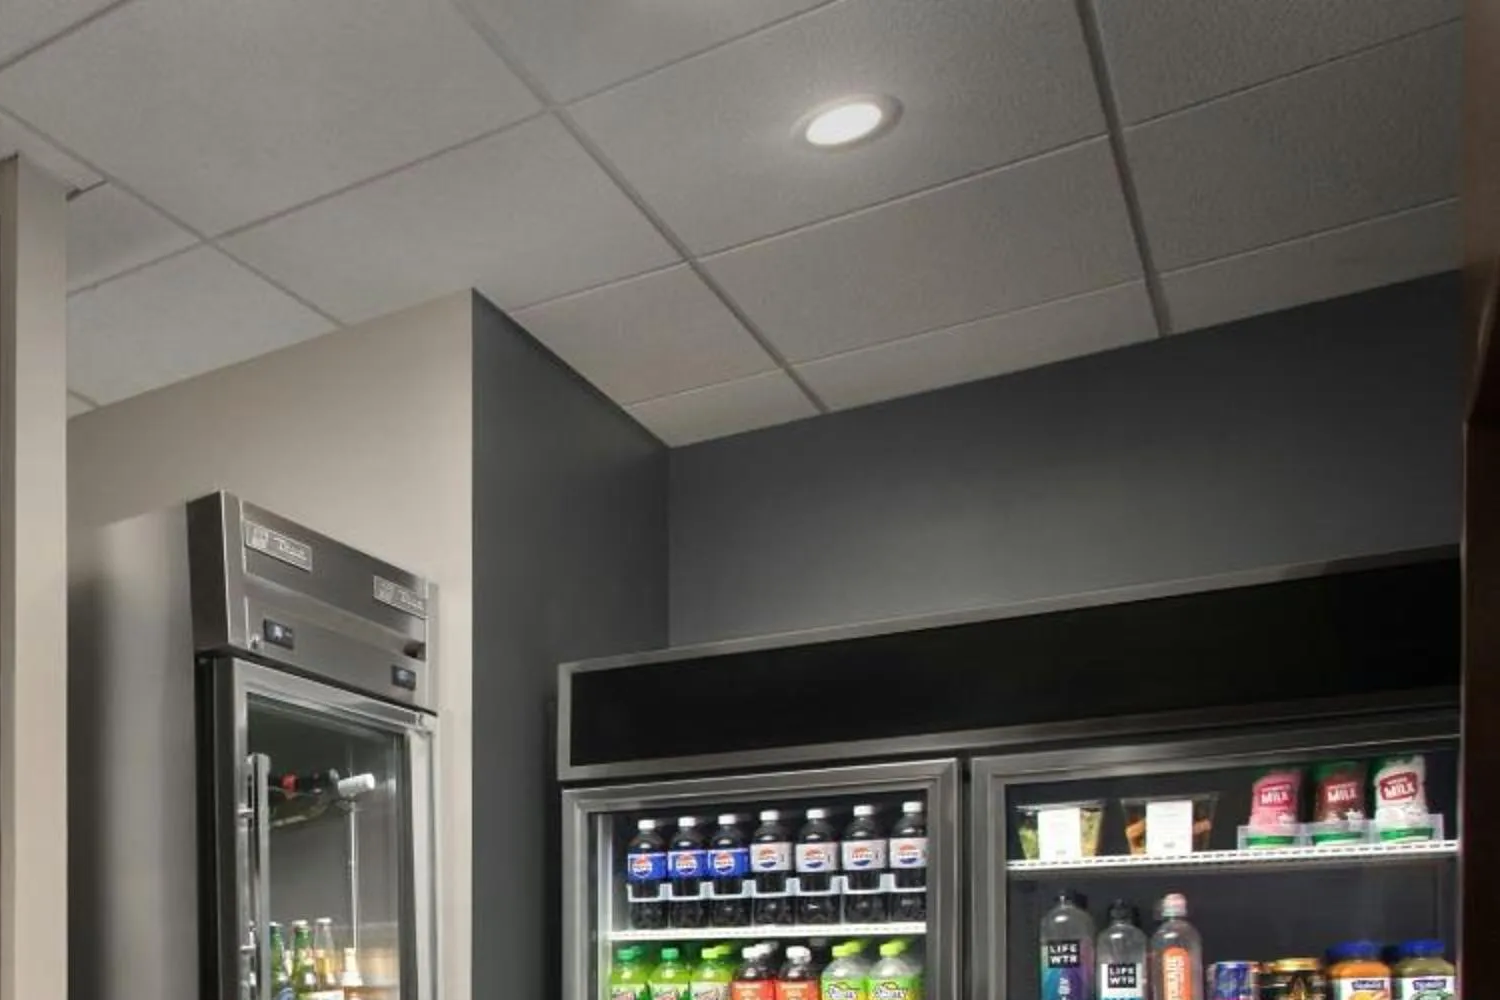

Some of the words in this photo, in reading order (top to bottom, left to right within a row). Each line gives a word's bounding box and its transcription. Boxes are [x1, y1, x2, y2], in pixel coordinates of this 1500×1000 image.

[1050, 943, 1078, 954] LIFE
[1050, 954, 1078, 965] WTR
[1109, 977, 1135, 986] WTR
